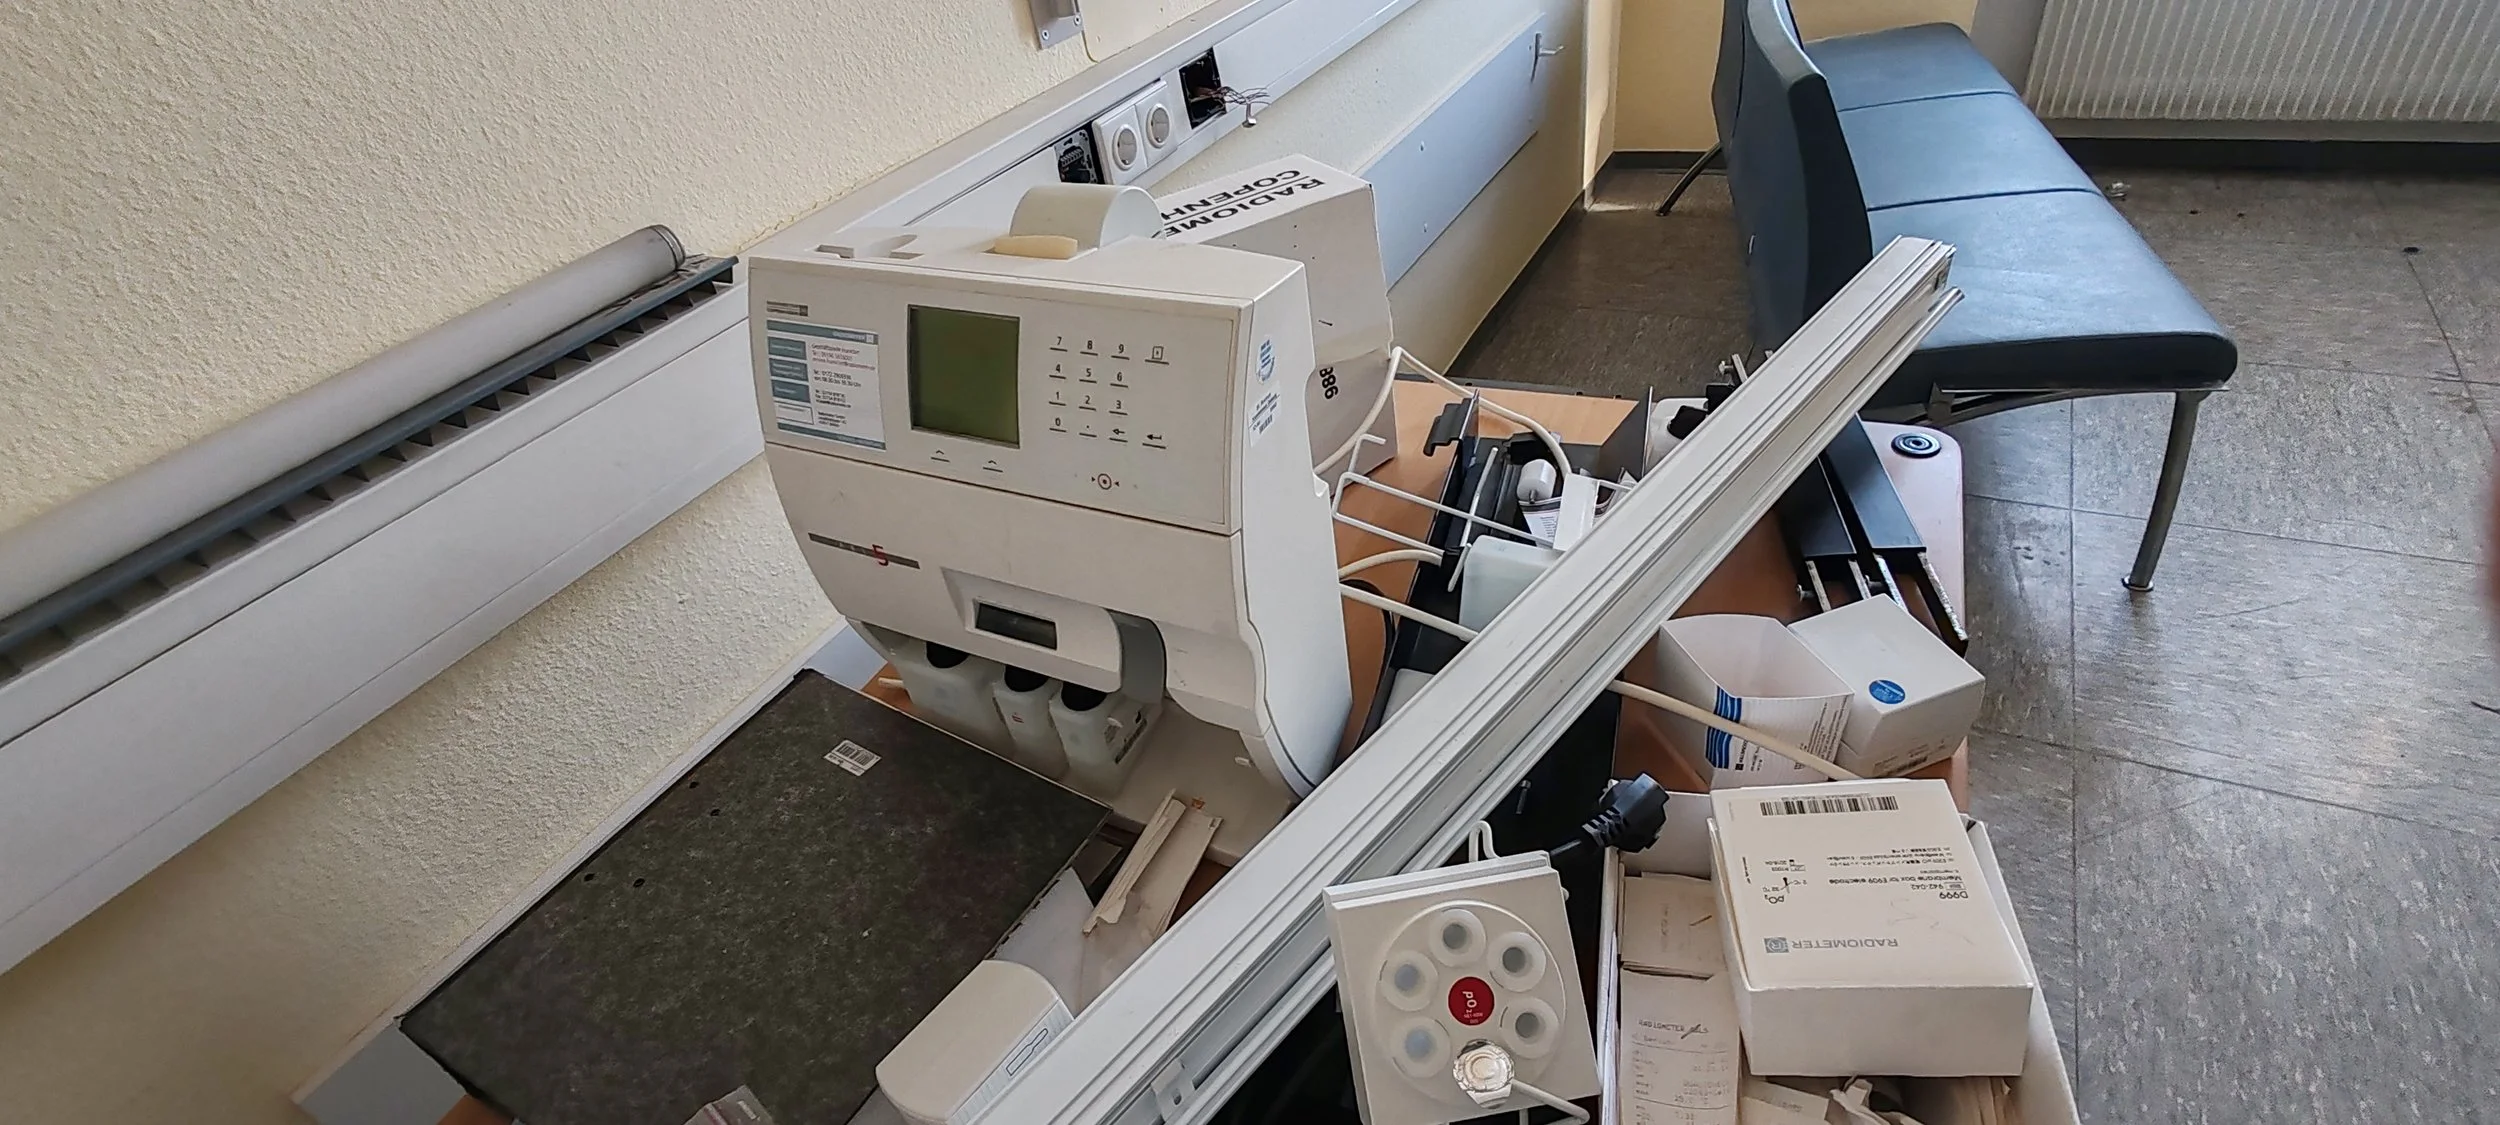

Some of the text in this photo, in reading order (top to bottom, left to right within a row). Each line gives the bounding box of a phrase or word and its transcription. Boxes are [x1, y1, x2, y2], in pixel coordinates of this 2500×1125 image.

[1056, 336, 1124, 354] 7 8 9
[1055, 364, 1123, 382] 4 5 6
[1085, 395, 1091, 405] 2
[1116, 400, 1122, 409] 3
[1055, 417, 1061, 427] 0
[1938, 891, 1968, 899] D999
[1791, 938, 1899, 949] RADIOMETER
